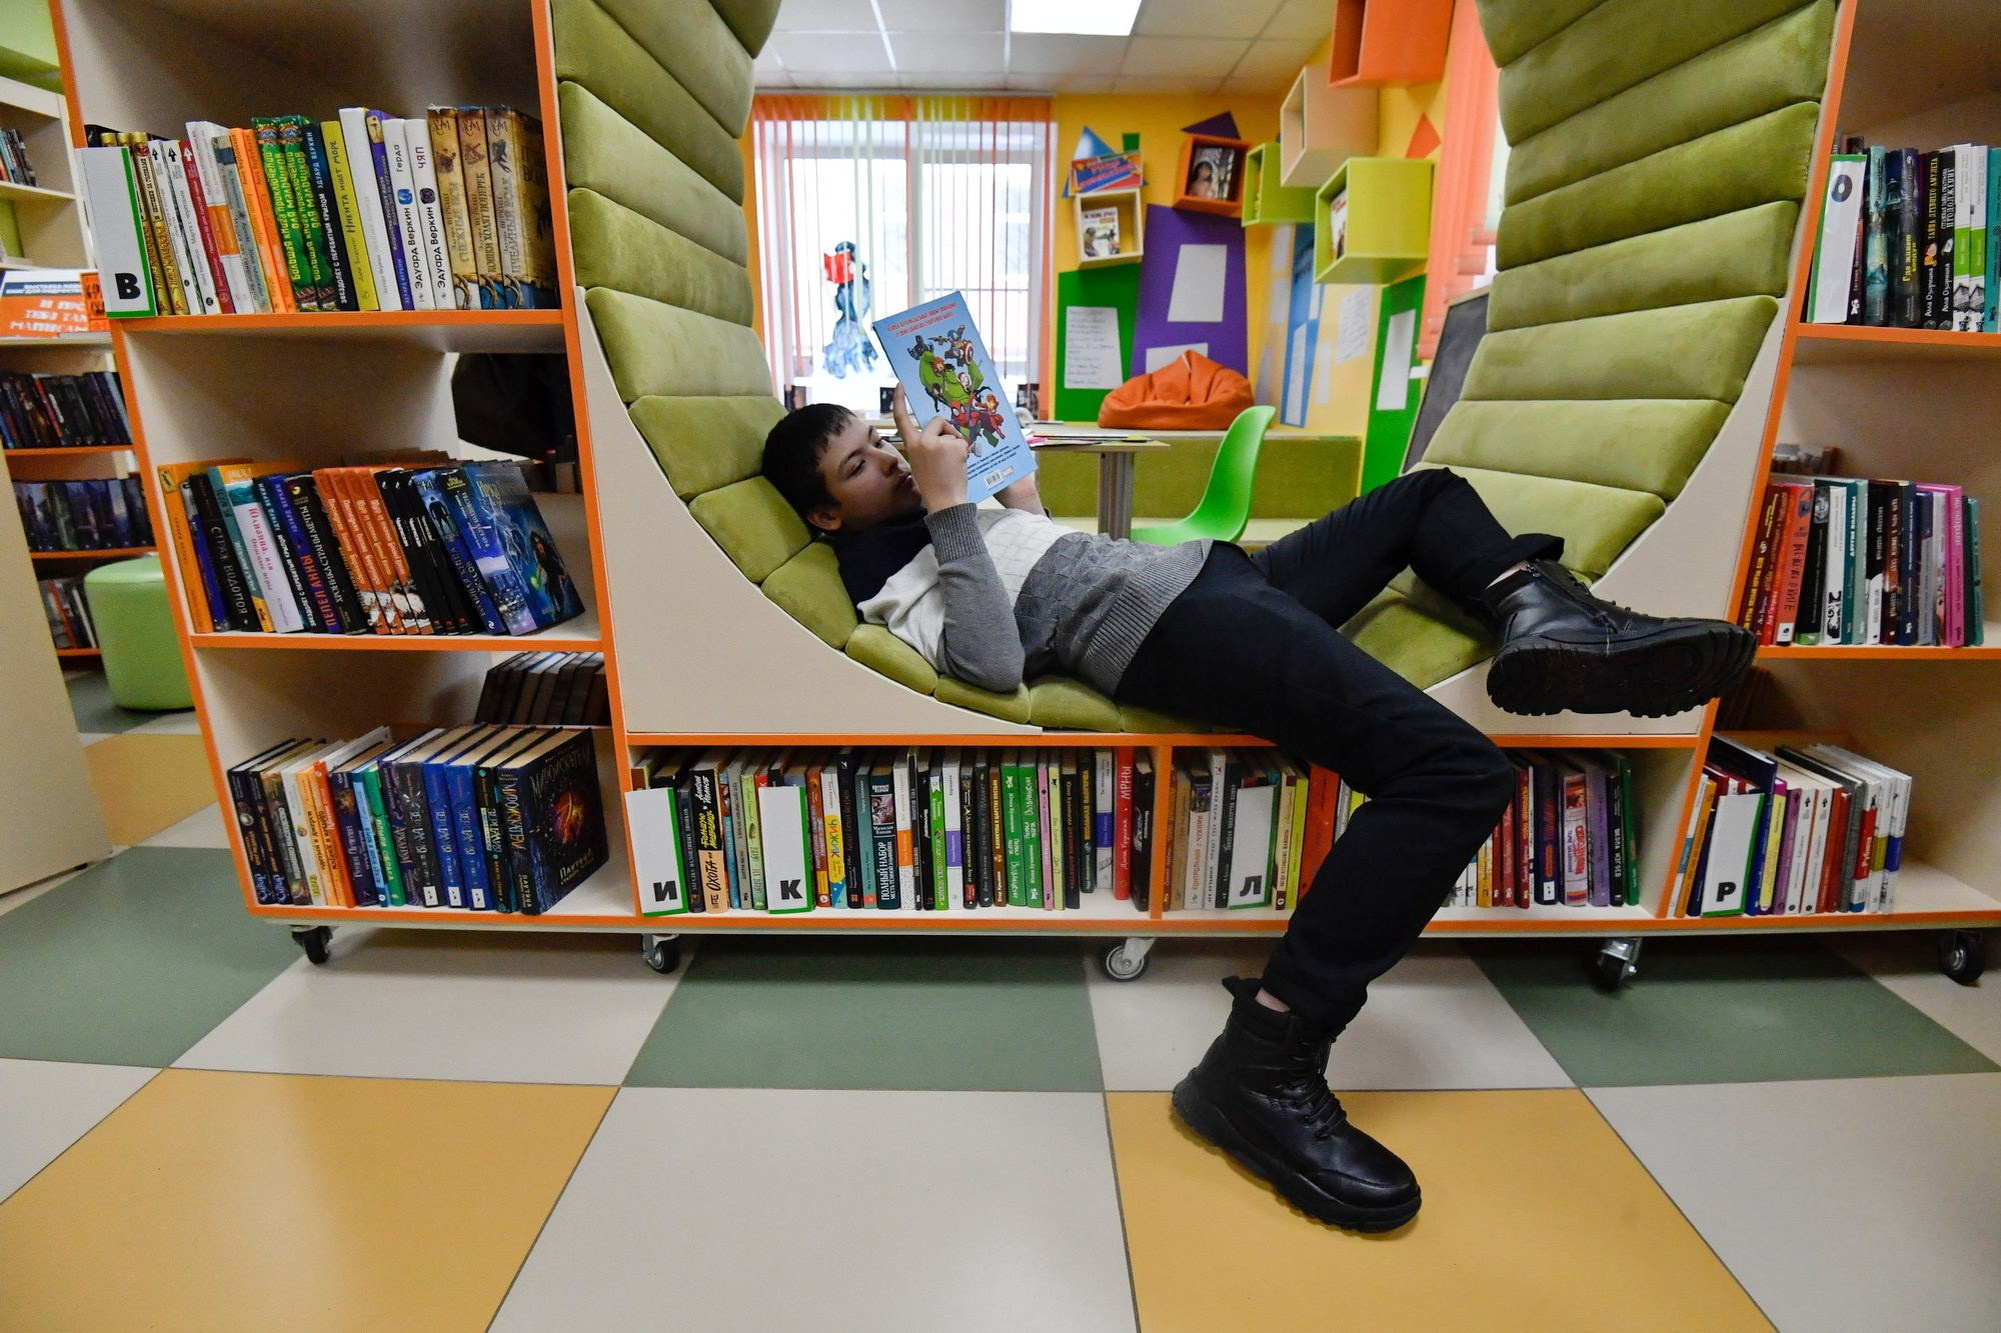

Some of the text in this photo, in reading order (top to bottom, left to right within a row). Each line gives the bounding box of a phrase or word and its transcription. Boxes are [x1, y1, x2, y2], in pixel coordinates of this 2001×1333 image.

[305, 131, 318, 160] ВЕРКИН
[391, 143, 405, 172] Герда
[414, 145, 427, 169] ЧЯП
[262, 151, 284, 212] приключений
[274, 151, 300, 229] для мальчиков
[286, 150, 307, 212] приключений
[294, 151, 319, 228] для мальчиков
[312, 161, 324, 189] ЭДУАРД
[318, 192, 330, 221] КРЫЛОМ
[1927, 157, 1938, 240] ТАЙНА ДРЕВНЕГО АМУЛЕТА
[1946, 167, 1956, 228] ПРОДОЛЖЕНИЕ
[277, 213, 290, 238] книга
[300, 213, 312, 239] книга
[324, 222, 338, 260] ПЕРЕБИТЫМ
[478, 212, 494, 240] ХОДЯТ
[400, 206, 426, 289] Эдуард Веркин
[422, 206, 448, 289] Эдуард Веркин
[482, 240, 497, 273] КОШКИ
[115, 273, 141, 300] В
[1901, 265, 1912, 282] Где
[1941, 262, 1952, 312] Алла Озорнина
[1924, 267, 1936, 316] Алла Озорнина
[258, 482, 272, 506] ВЕРКИН
[274, 482, 289, 508] ВЕРКИН
[277, 533, 291, 558] КРЫЛОМ
[299, 504, 344, 604] ХРОНИКА СТРАНЫ МЕЧТЫ
[209, 524, 230, 561] СТРАХ
[223, 563, 247, 615] ВОДОПОЯ
[286, 557, 303, 590] ПЕРЕБИТЫМ
[300, 553, 337, 627] ПЕПЕЛ АННЫ
[1120, 766, 1132, 799] МРНЫ
[824, 818, 844, 859] ЧИЖИК
[700, 858, 722, 893] ОХОТА
[878, 841, 889, 899] ПОЛНЫЙ НАБОР
[1240, 875, 1262, 897] Л
[520, 873, 532, 907] ПАУТИНА
[654, 880, 678, 902] И
[780, 879, 803, 900] К
[1716, 882, 1736, 902] Р
